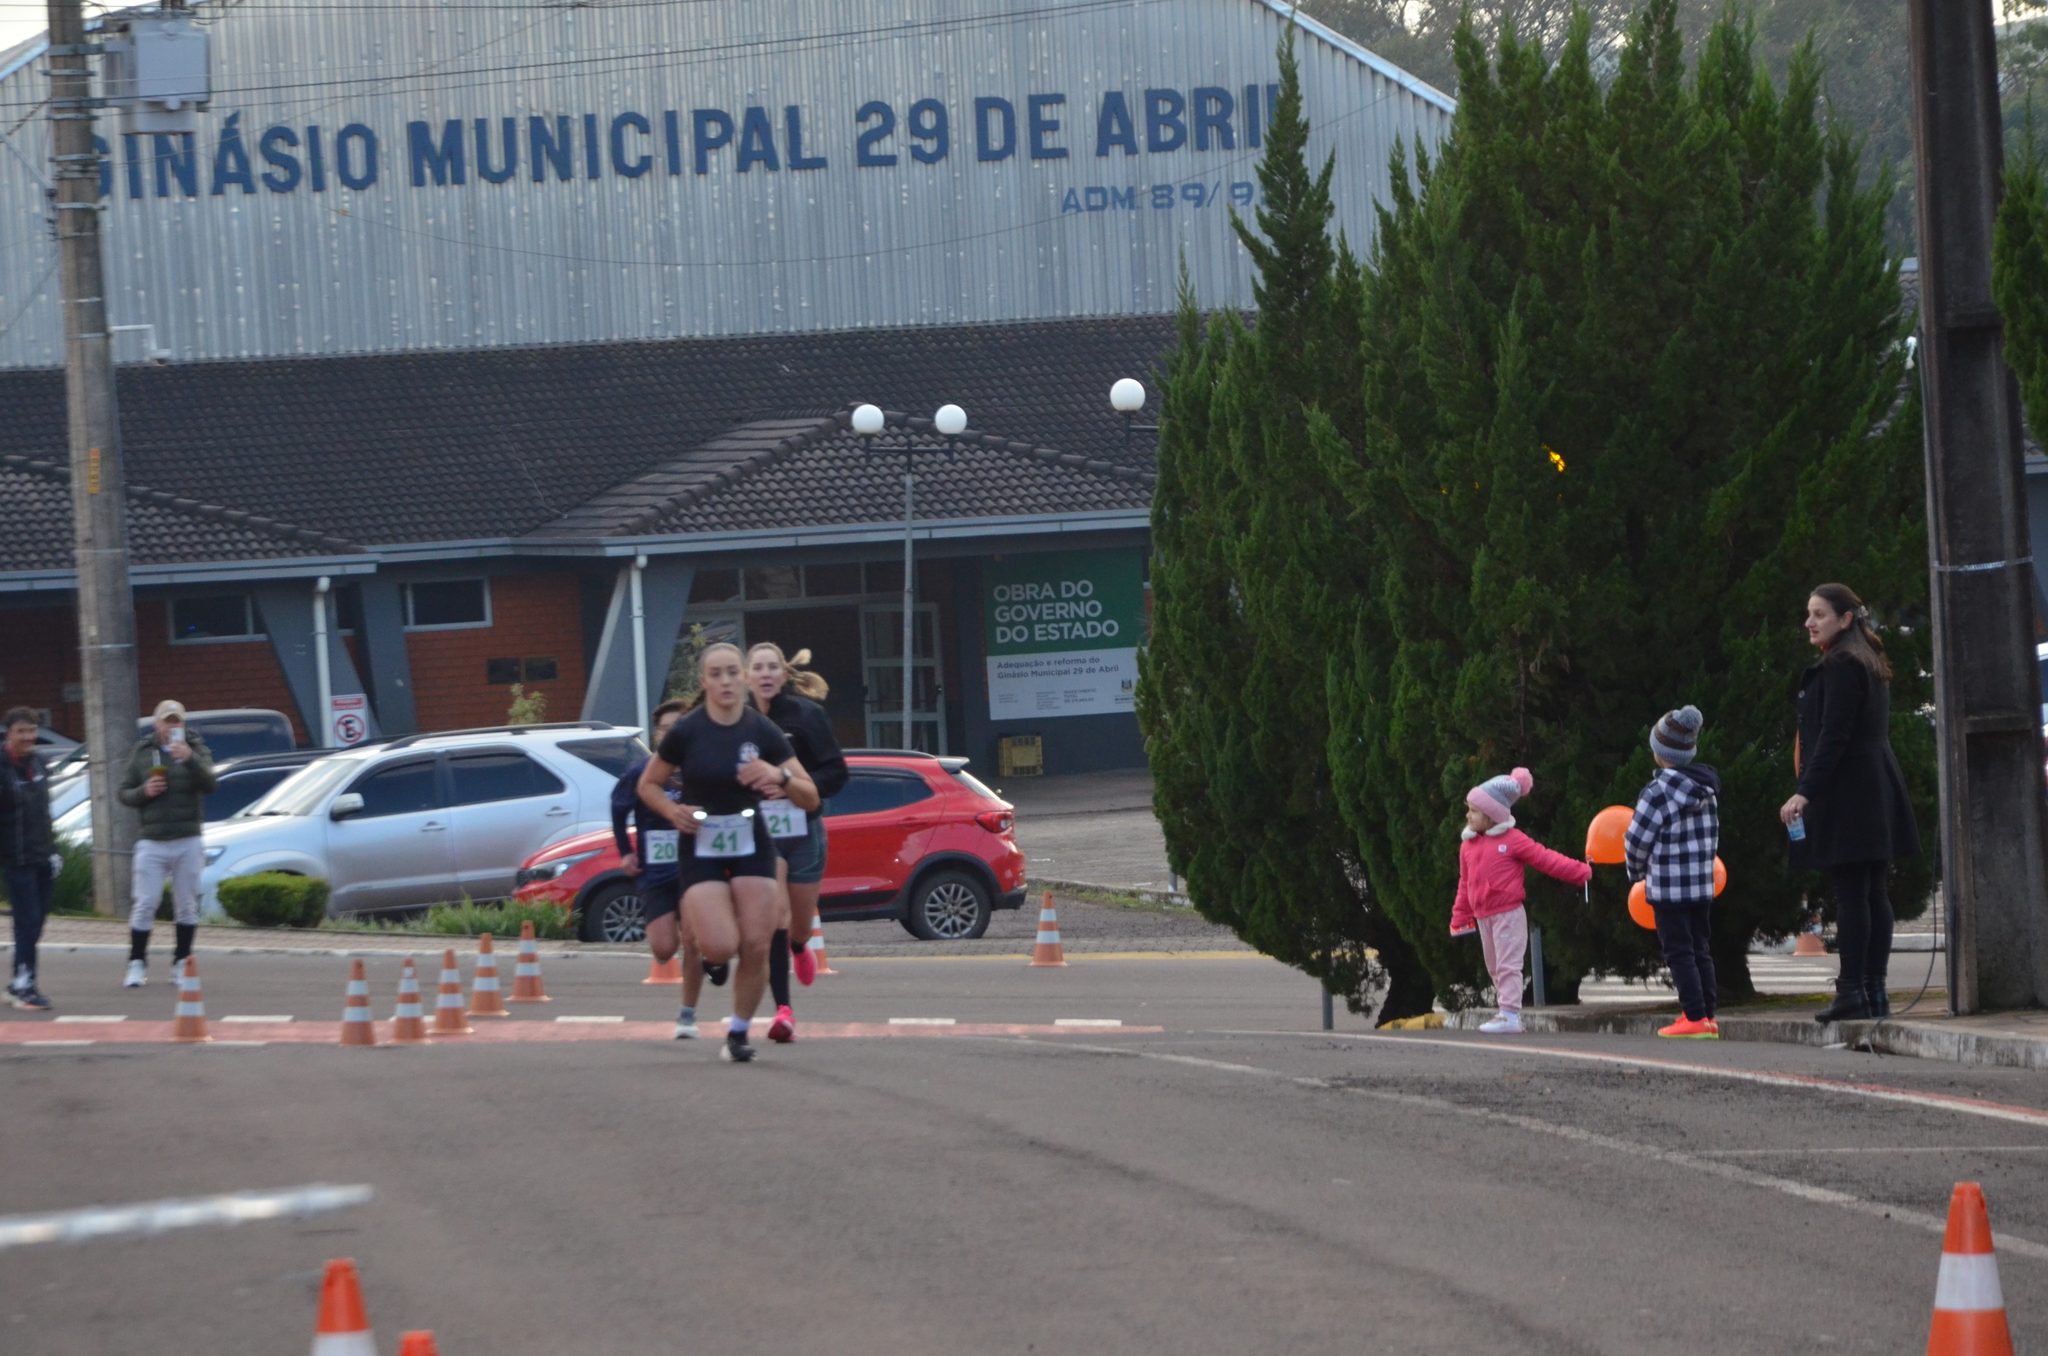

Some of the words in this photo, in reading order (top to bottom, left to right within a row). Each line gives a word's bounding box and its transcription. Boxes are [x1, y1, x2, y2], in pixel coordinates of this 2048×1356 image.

[407, 104, 828, 188] MUNICIPAL
[857, 97, 950, 168] 29
[974, 92, 1068, 163] DE
[1061, 185, 1136, 213] ADM
[1151, 180, 1266, 209] 89/9
[993, 582, 1056, 602] OBRA
[1060, 579, 1094, 598] DO
[994, 600, 1103, 622] GOVERNO
[996, 625, 1029, 644] DO
[1034, 619, 1120, 641] ESTADO
[997, 659, 1045, 670] Adequação
[1054, 657, 1087, 667] reforma
[1089, 656, 1100, 664] do
[1031, 667, 1071, 678] Municipal
[1072, 667, 1084, 675] 29
[1085, 666, 1097, 674] de
[1099, 664, 1120, 673] Abril
[768, 814, 792, 834] 21
[653, 842, 676, 860] 20
[711, 830, 739, 853] 41
